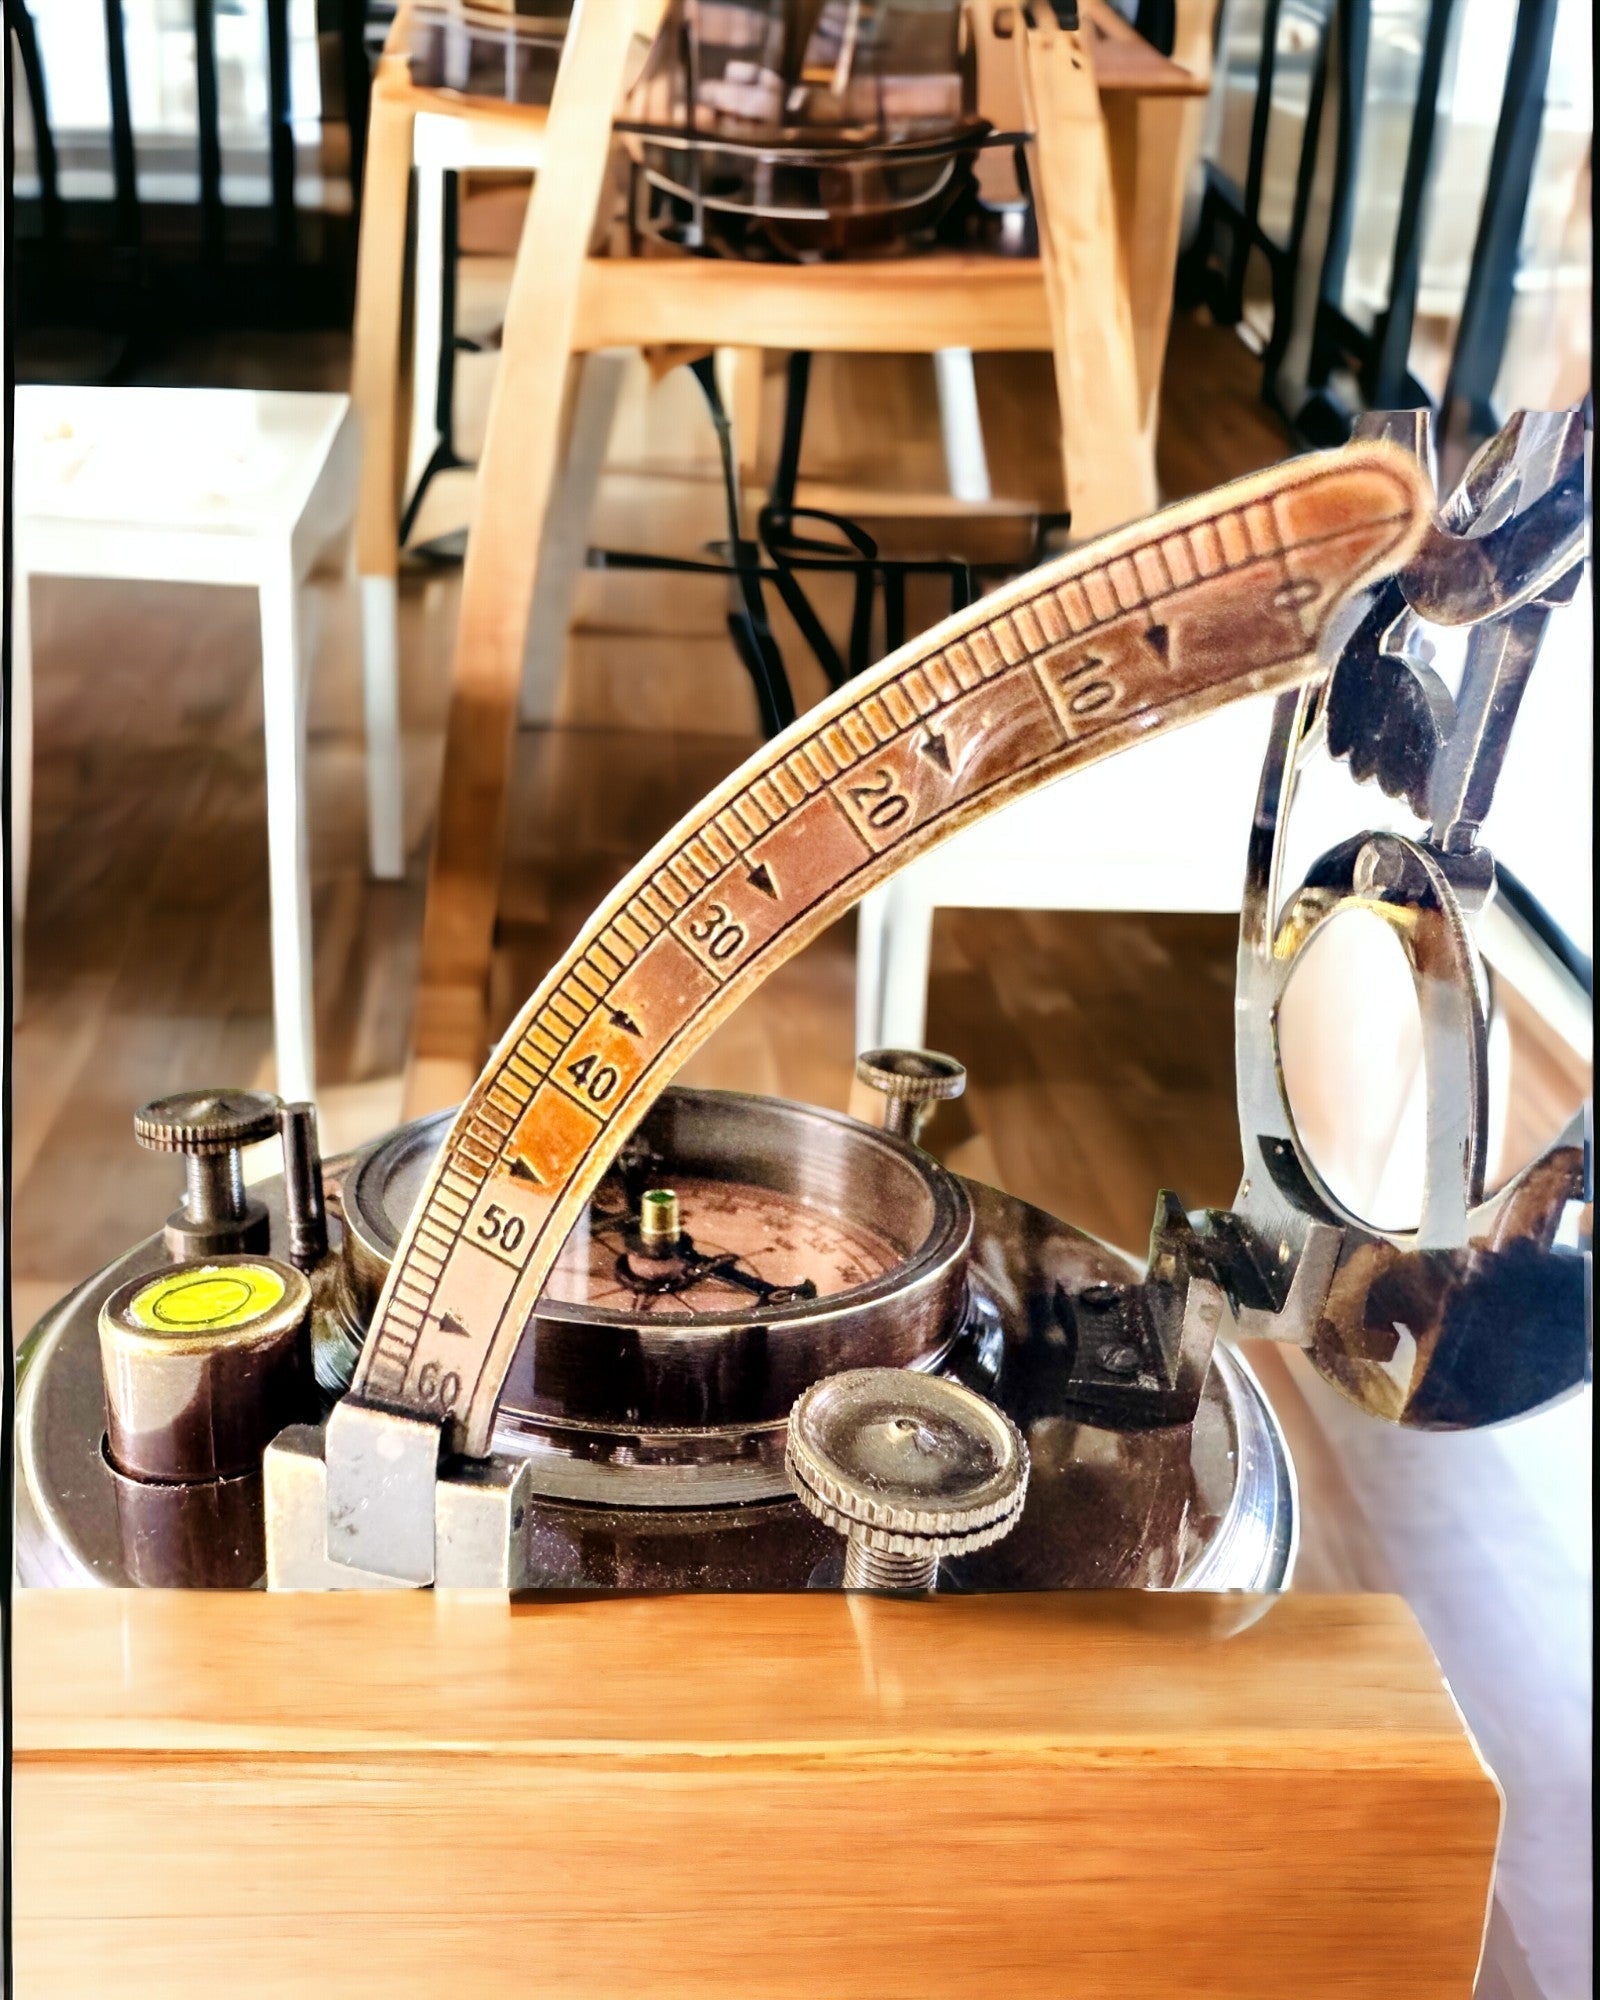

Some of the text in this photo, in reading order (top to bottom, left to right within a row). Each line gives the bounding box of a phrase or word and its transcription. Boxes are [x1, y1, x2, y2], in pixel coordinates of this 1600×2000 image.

[1058, 652, 1117, 715] 10
[847, 769, 910, 829] 20
[689, 904, 745, 962] 30
[567, 1053, 619, 1103] 40
[475, 1203, 527, 1254] 50
[418, 1361, 462, 1413] 60
